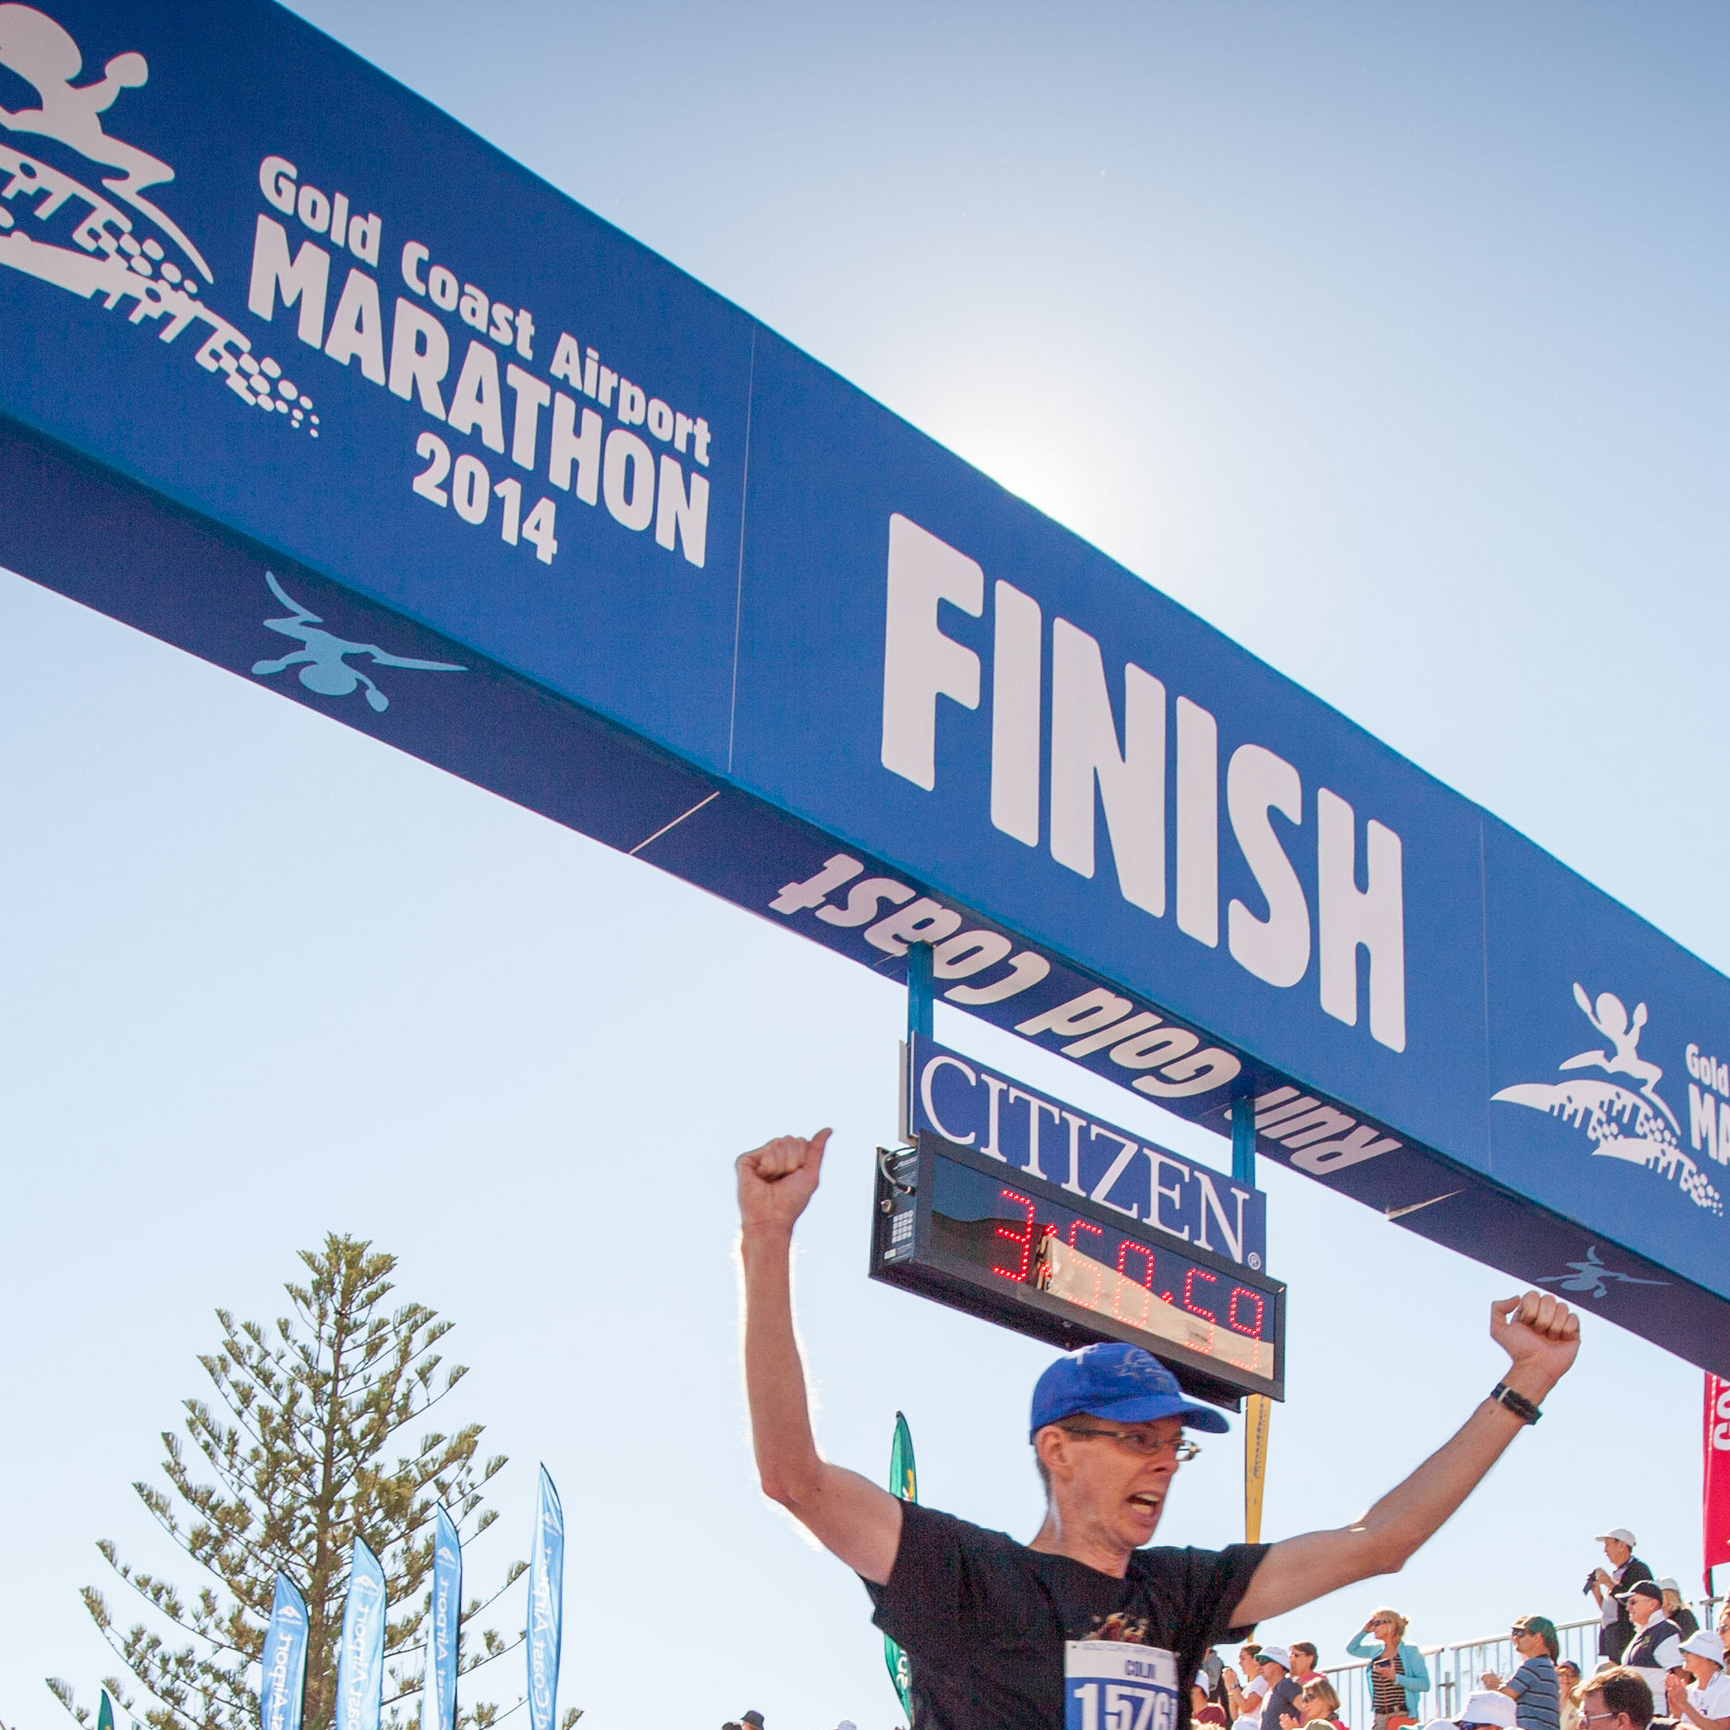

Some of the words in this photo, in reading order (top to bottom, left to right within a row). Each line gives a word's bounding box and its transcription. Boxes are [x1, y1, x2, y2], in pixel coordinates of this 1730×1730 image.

[248, 212, 710, 569] MARATHON
[259, 155, 382, 268] Gold
[401, 241, 535, 361] Coast
[549, 332, 711, 467] Airport
[412, 432, 558, 565] 2014
[881, 512, 1406, 1053] FINISH
[769, 853, 1050, 1004] Coast
[1015, 987, 1242, 1098] Gold
[1686, 1043, 1730, 1098] Gold
[920, 1055, 1251, 1265] CITIZEN
